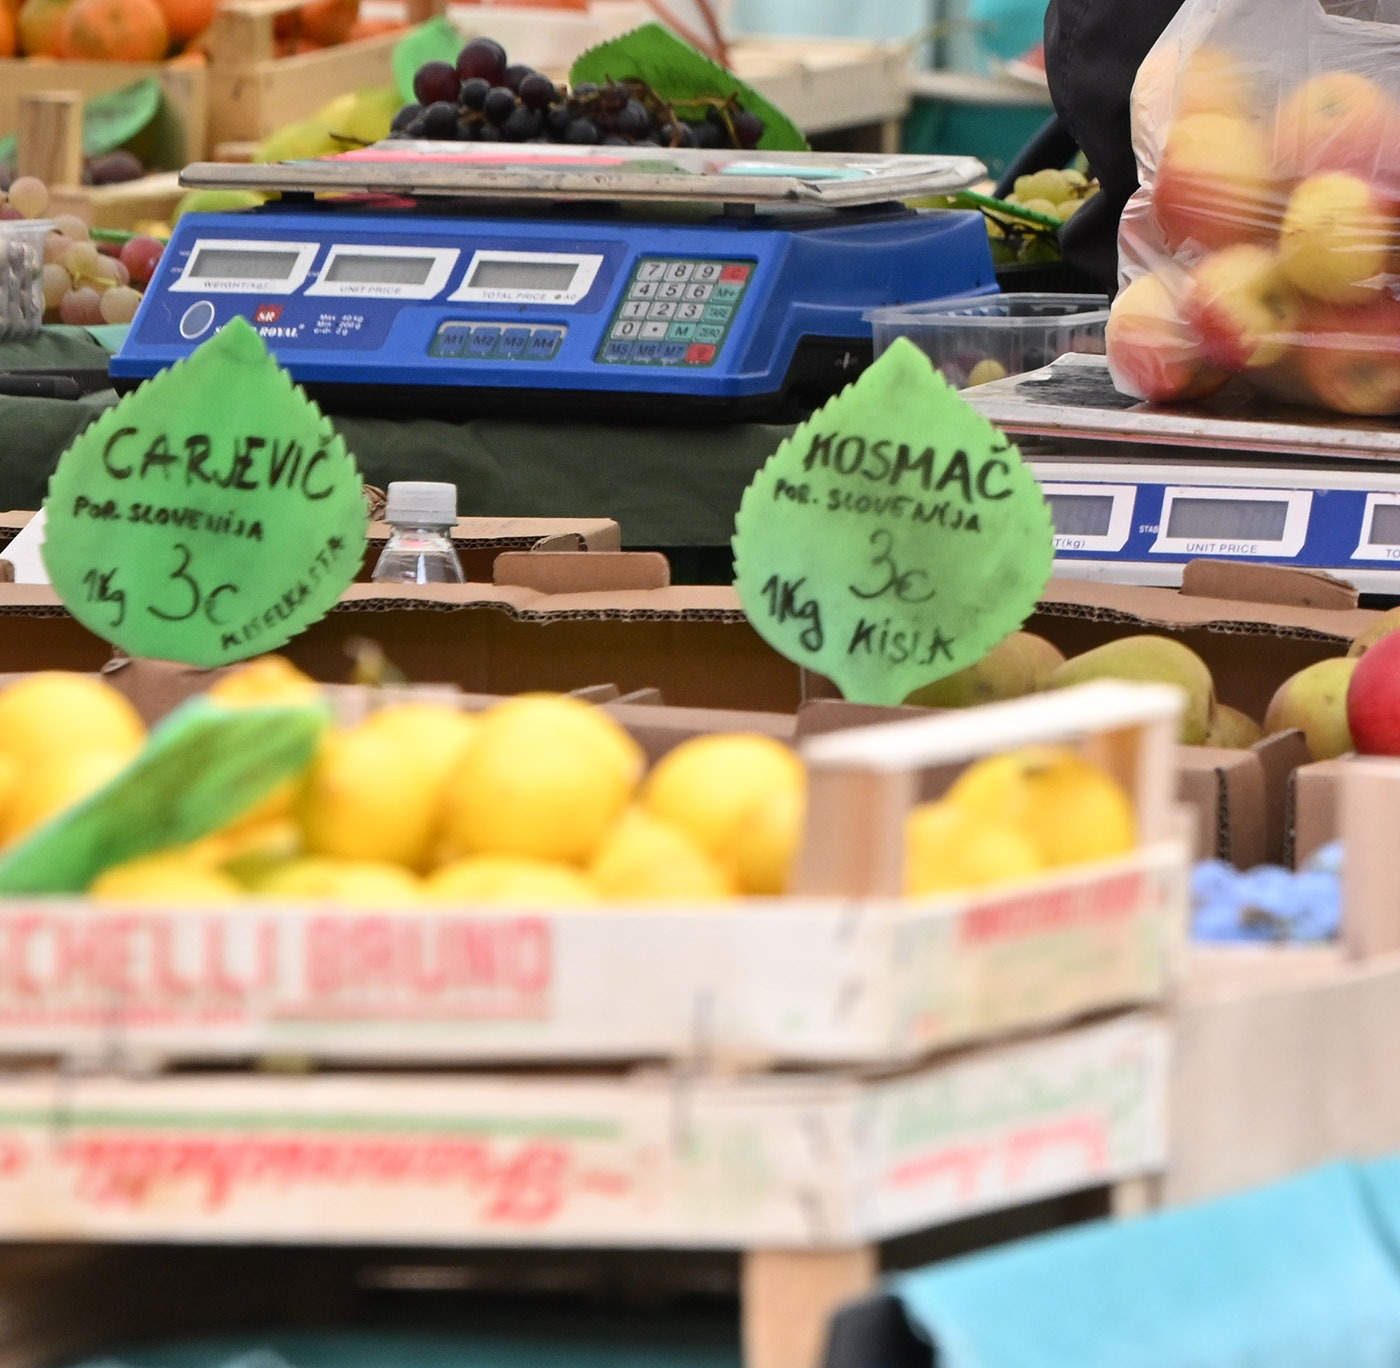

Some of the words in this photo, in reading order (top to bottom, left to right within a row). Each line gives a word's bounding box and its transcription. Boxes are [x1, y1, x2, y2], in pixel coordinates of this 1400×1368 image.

[648, 263, 660, 276] 7
[674, 264, 686, 277] 8
[702, 265, 714, 278] 9
[639, 283, 650, 295] 4
[665, 284, 677, 296] 5
[693, 285, 705, 298] 6
[632, 302, 641, 315] 1
[656, 303, 669, 316] 2
[684, 305, 697, 317] 3
[675, 326, 689, 335] M
[103, 426, 335, 501] CARJEVIČ
[803, 432, 1014, 505] KOSMAČ
[773, 478, 818, 505] POR.
[1186, 543, 1217, 553] UNIT
[1219, 544, 1259, 554] PRICE
[847, 528, 937, 604] 3€
